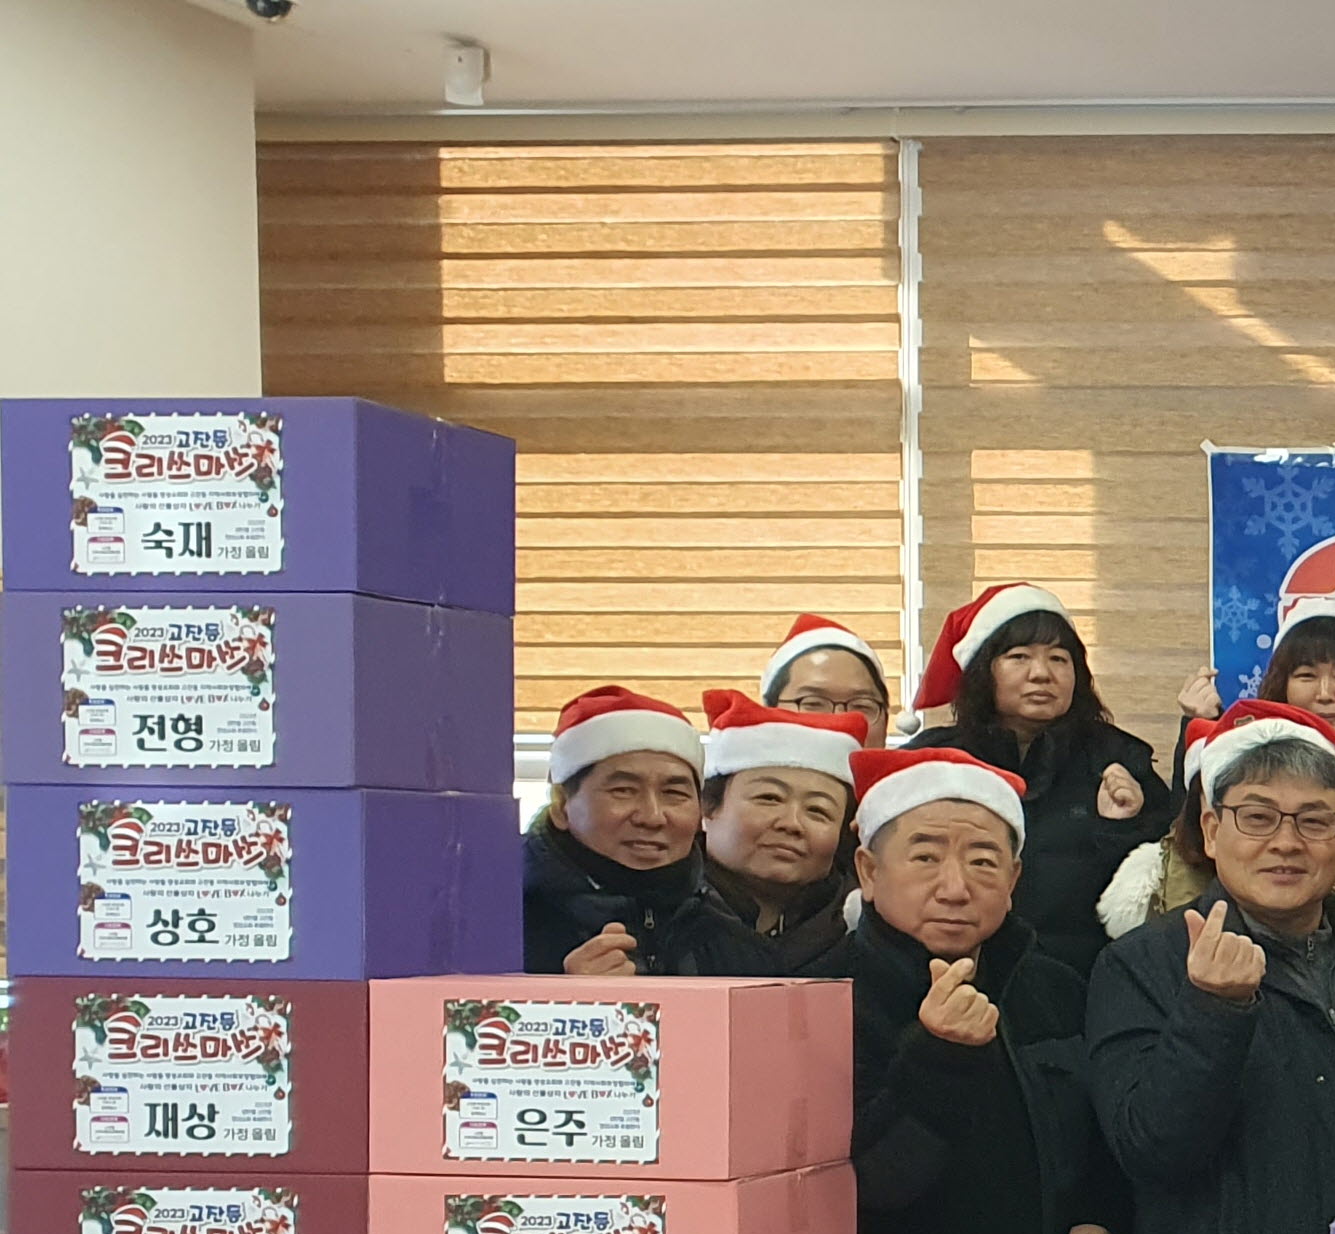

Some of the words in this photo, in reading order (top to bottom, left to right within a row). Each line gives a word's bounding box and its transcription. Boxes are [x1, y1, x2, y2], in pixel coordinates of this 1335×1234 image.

[141, 521, 211, 558] 숙재
[133, 627, 165, 638] 2023
[168, 623, 222, 641] 고잔동
[133, 713, 203, 752] 전형
[146, 908, 219, 946] 상호
[225, 934, 250, 947] 가정
[253, 934, 277, 947] 올림
[517, 1022, 549, 1032] 2023
[552, 1018, 606, 1037] 고잔동
[144, 1102, 219, 1140] 재상
[515, 1108, 587, 1146] 은주
